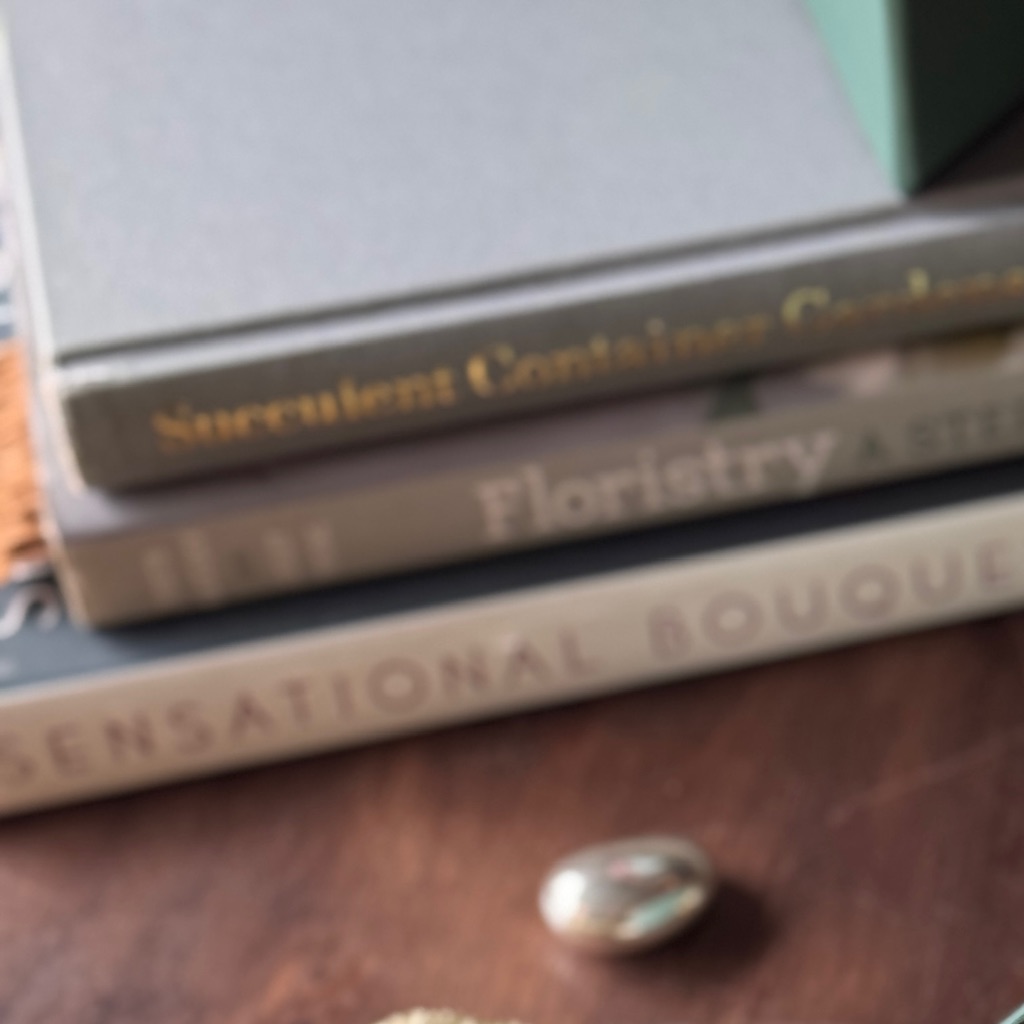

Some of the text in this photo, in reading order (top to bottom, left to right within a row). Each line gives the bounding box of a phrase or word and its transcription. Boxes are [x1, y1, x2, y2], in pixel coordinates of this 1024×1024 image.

[150, 365, 456, 450] Succulent
[465, 314, 770, 397] Container
[474, 431, 838, 543] Floristry
[0, 628, 597, 786] SENSATIONAL
